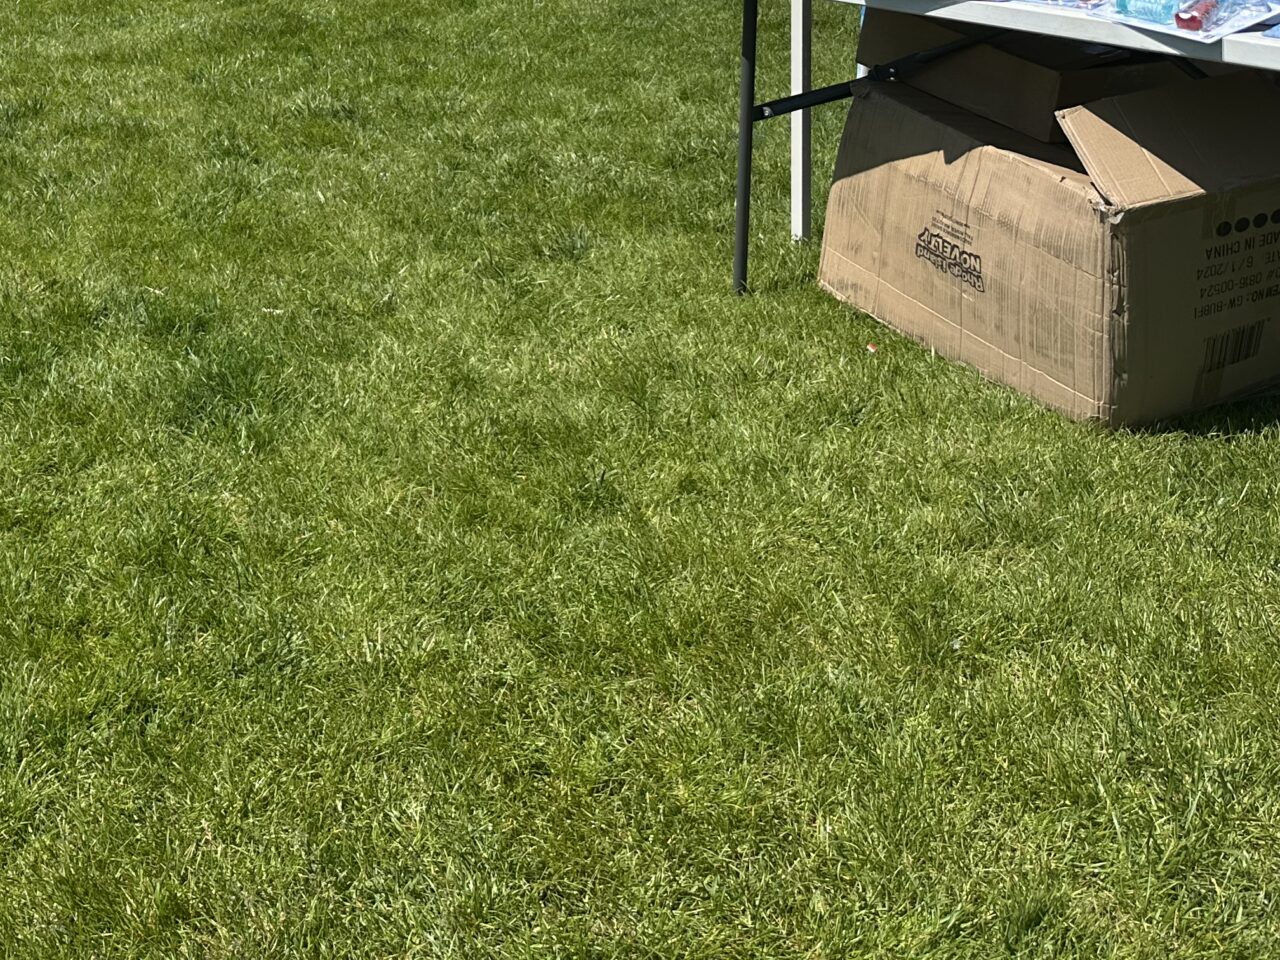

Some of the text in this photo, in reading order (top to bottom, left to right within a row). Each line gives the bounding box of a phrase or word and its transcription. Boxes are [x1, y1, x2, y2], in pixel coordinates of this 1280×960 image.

[918, 227, 981, 274] NOVELTY
[1205, 231, 1280, 261] ADE IN CHINA
[948, 262, 985, 293] Rhode
[1197, 256, 1254, 281] 6/1/2024
[1199, 271, 1263, 299] 0816-00524
